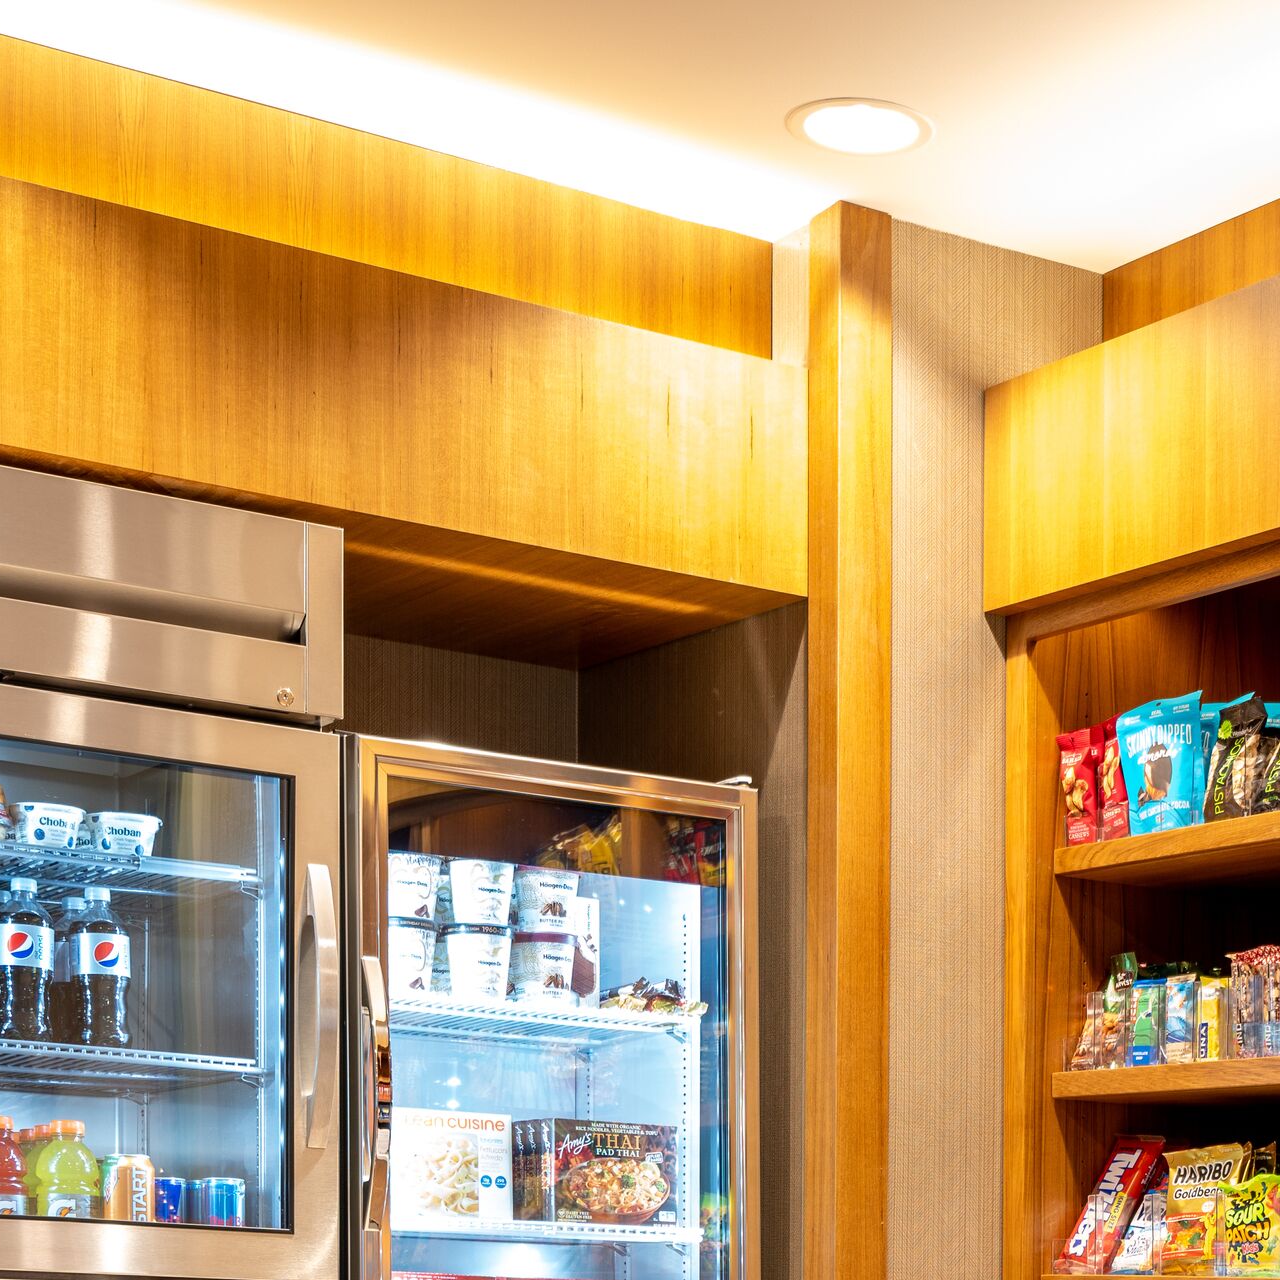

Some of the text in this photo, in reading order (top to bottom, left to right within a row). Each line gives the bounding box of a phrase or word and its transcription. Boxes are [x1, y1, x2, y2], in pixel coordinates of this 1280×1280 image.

[1214, 737, 1245, 815] PISTACHIOS
[558, 1132, 592, 1158] Amy's
[593, 1133, 641, 1149] THAI
[1173, 1160, 1233, 1186] HARIBO
[1225, 1203, 1265, 1227] SOUR
[1226, 1222, 1271, 1242] PATCH
